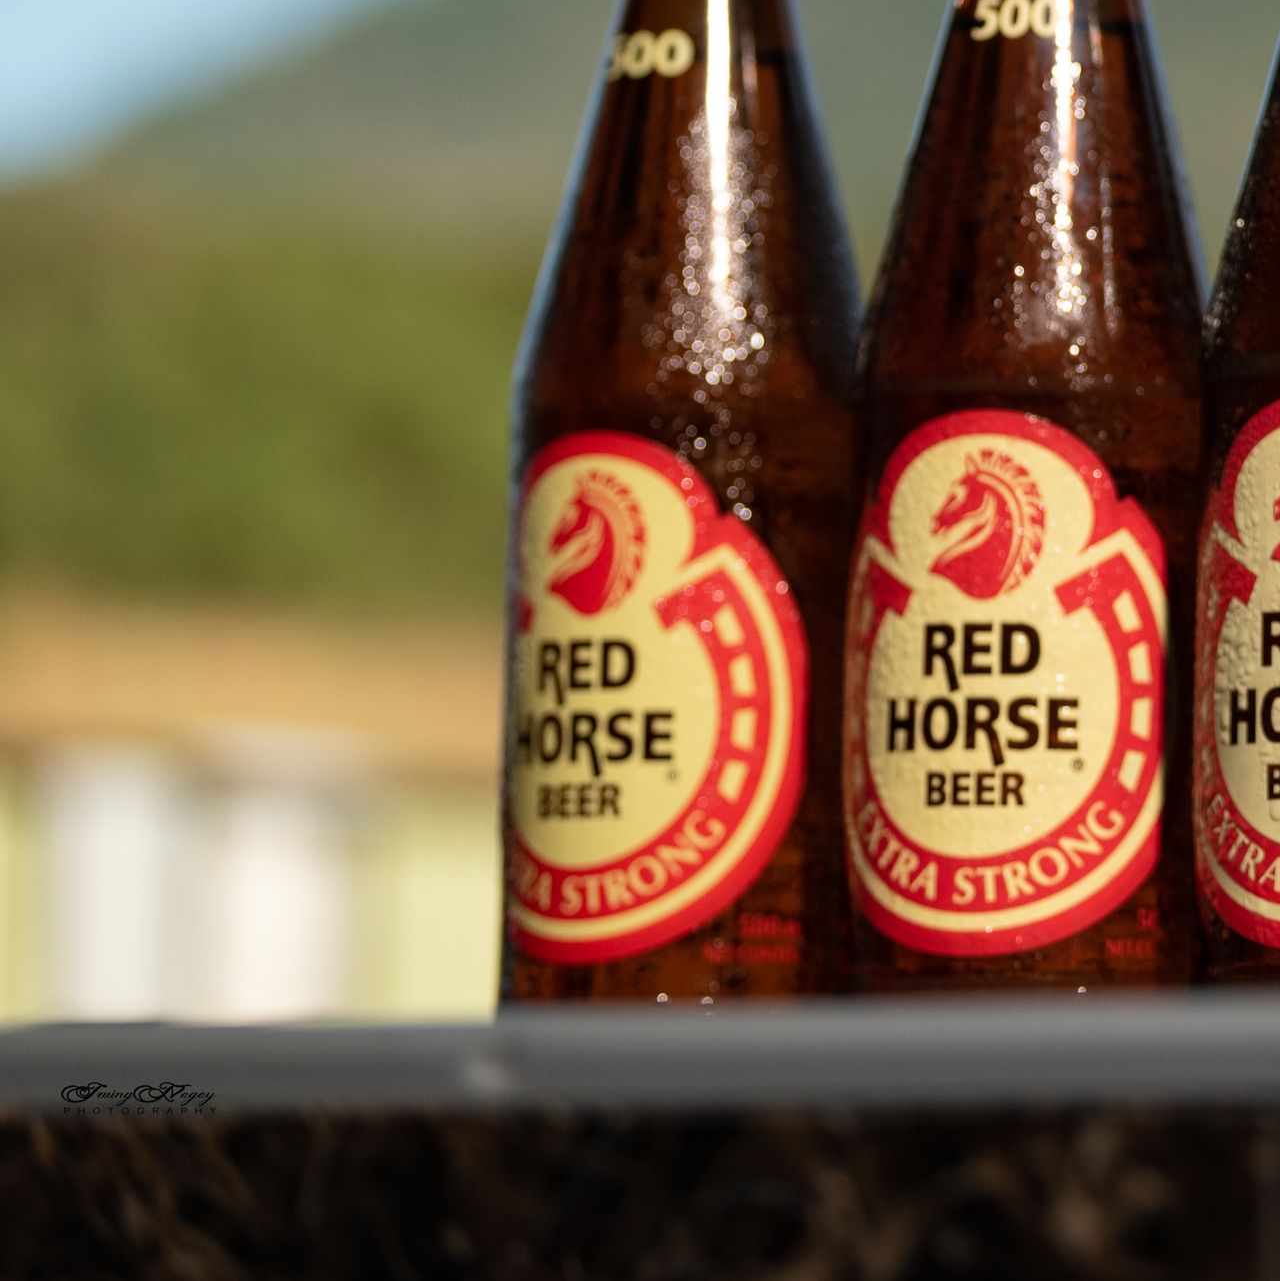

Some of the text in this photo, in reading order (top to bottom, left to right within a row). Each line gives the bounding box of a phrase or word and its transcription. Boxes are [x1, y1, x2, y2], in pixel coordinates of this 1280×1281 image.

[538, 637, 636, 706] RED
[923, 623, 1041, 692] RED
[886, 696, 1079, 767] HORSE
[537, 784, 620, 819] BEER
[925, 771, 1025, 808] BEER
[559, 808, 727, 916] STRONG
[857, 800, 1125, 906] EXTRA STRONG
